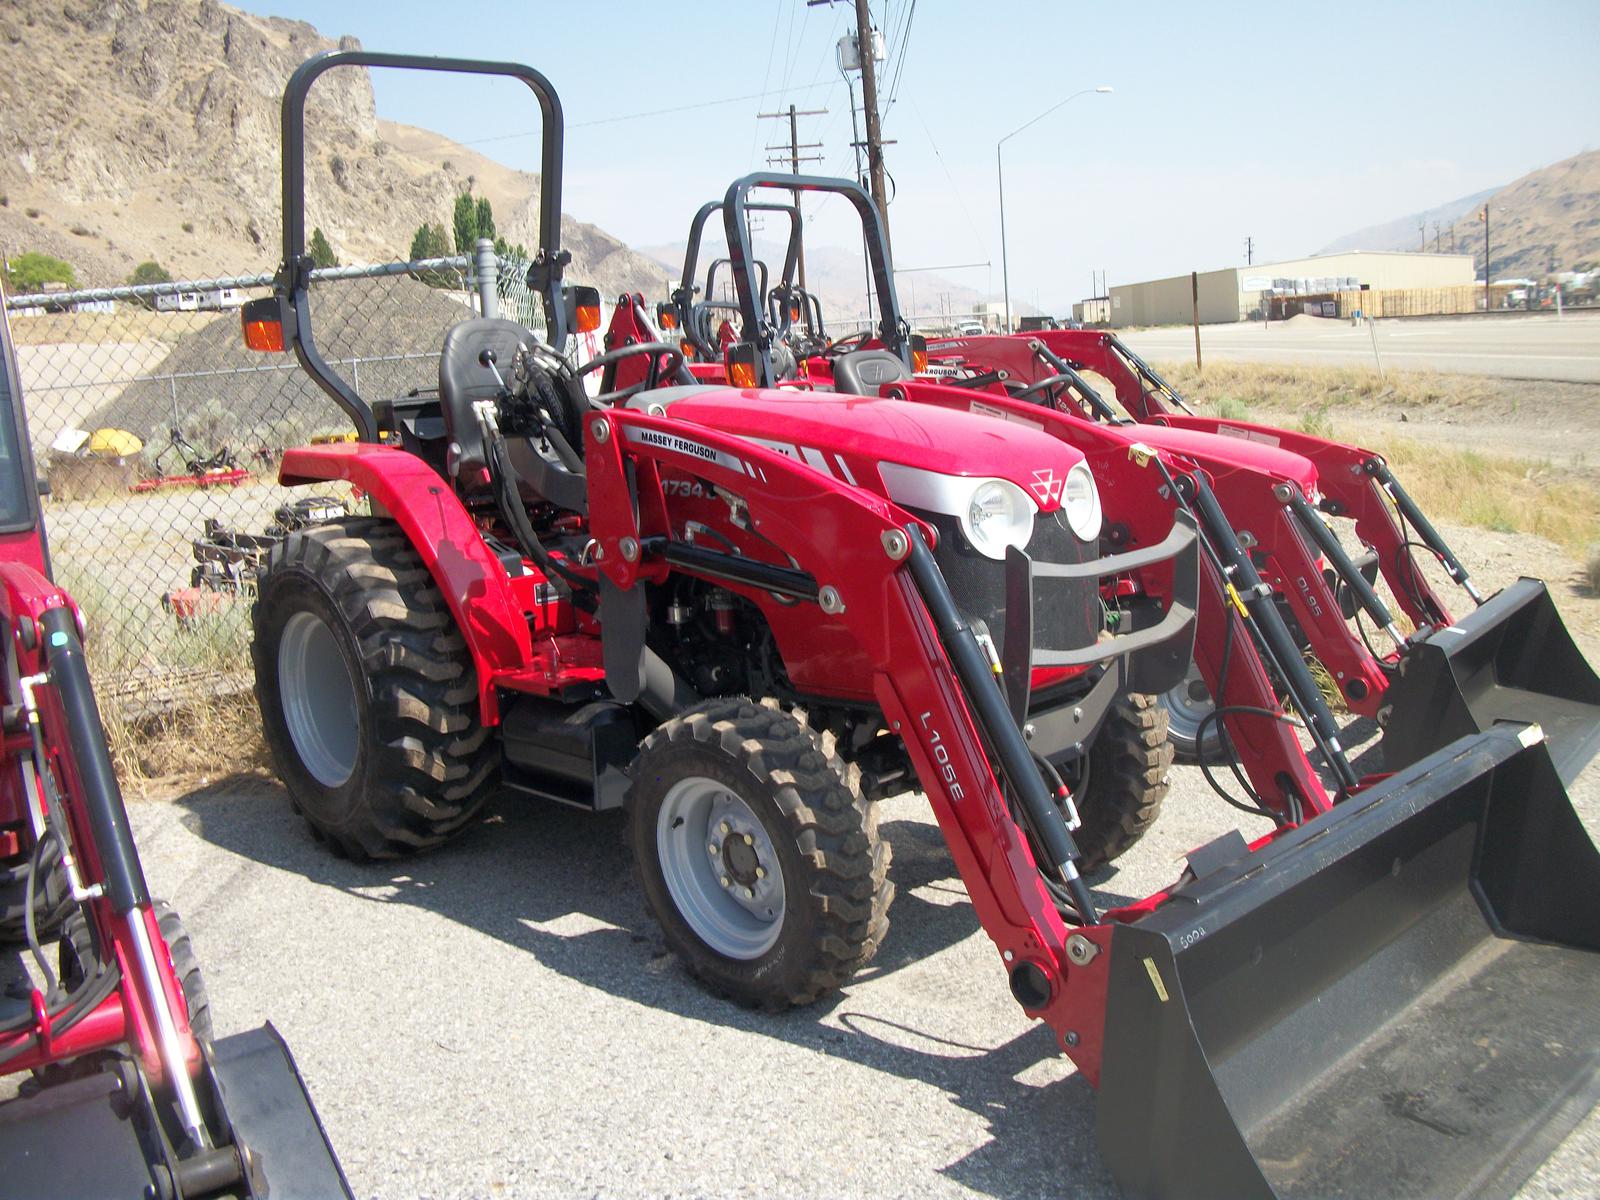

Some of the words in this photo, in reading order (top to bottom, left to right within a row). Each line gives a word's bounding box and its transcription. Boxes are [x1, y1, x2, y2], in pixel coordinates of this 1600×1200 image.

[641, 431, 673, 447] MASSEY
[674, 439, 717, 461] FERGUSON
[920, 711, 965, 801] L105E
